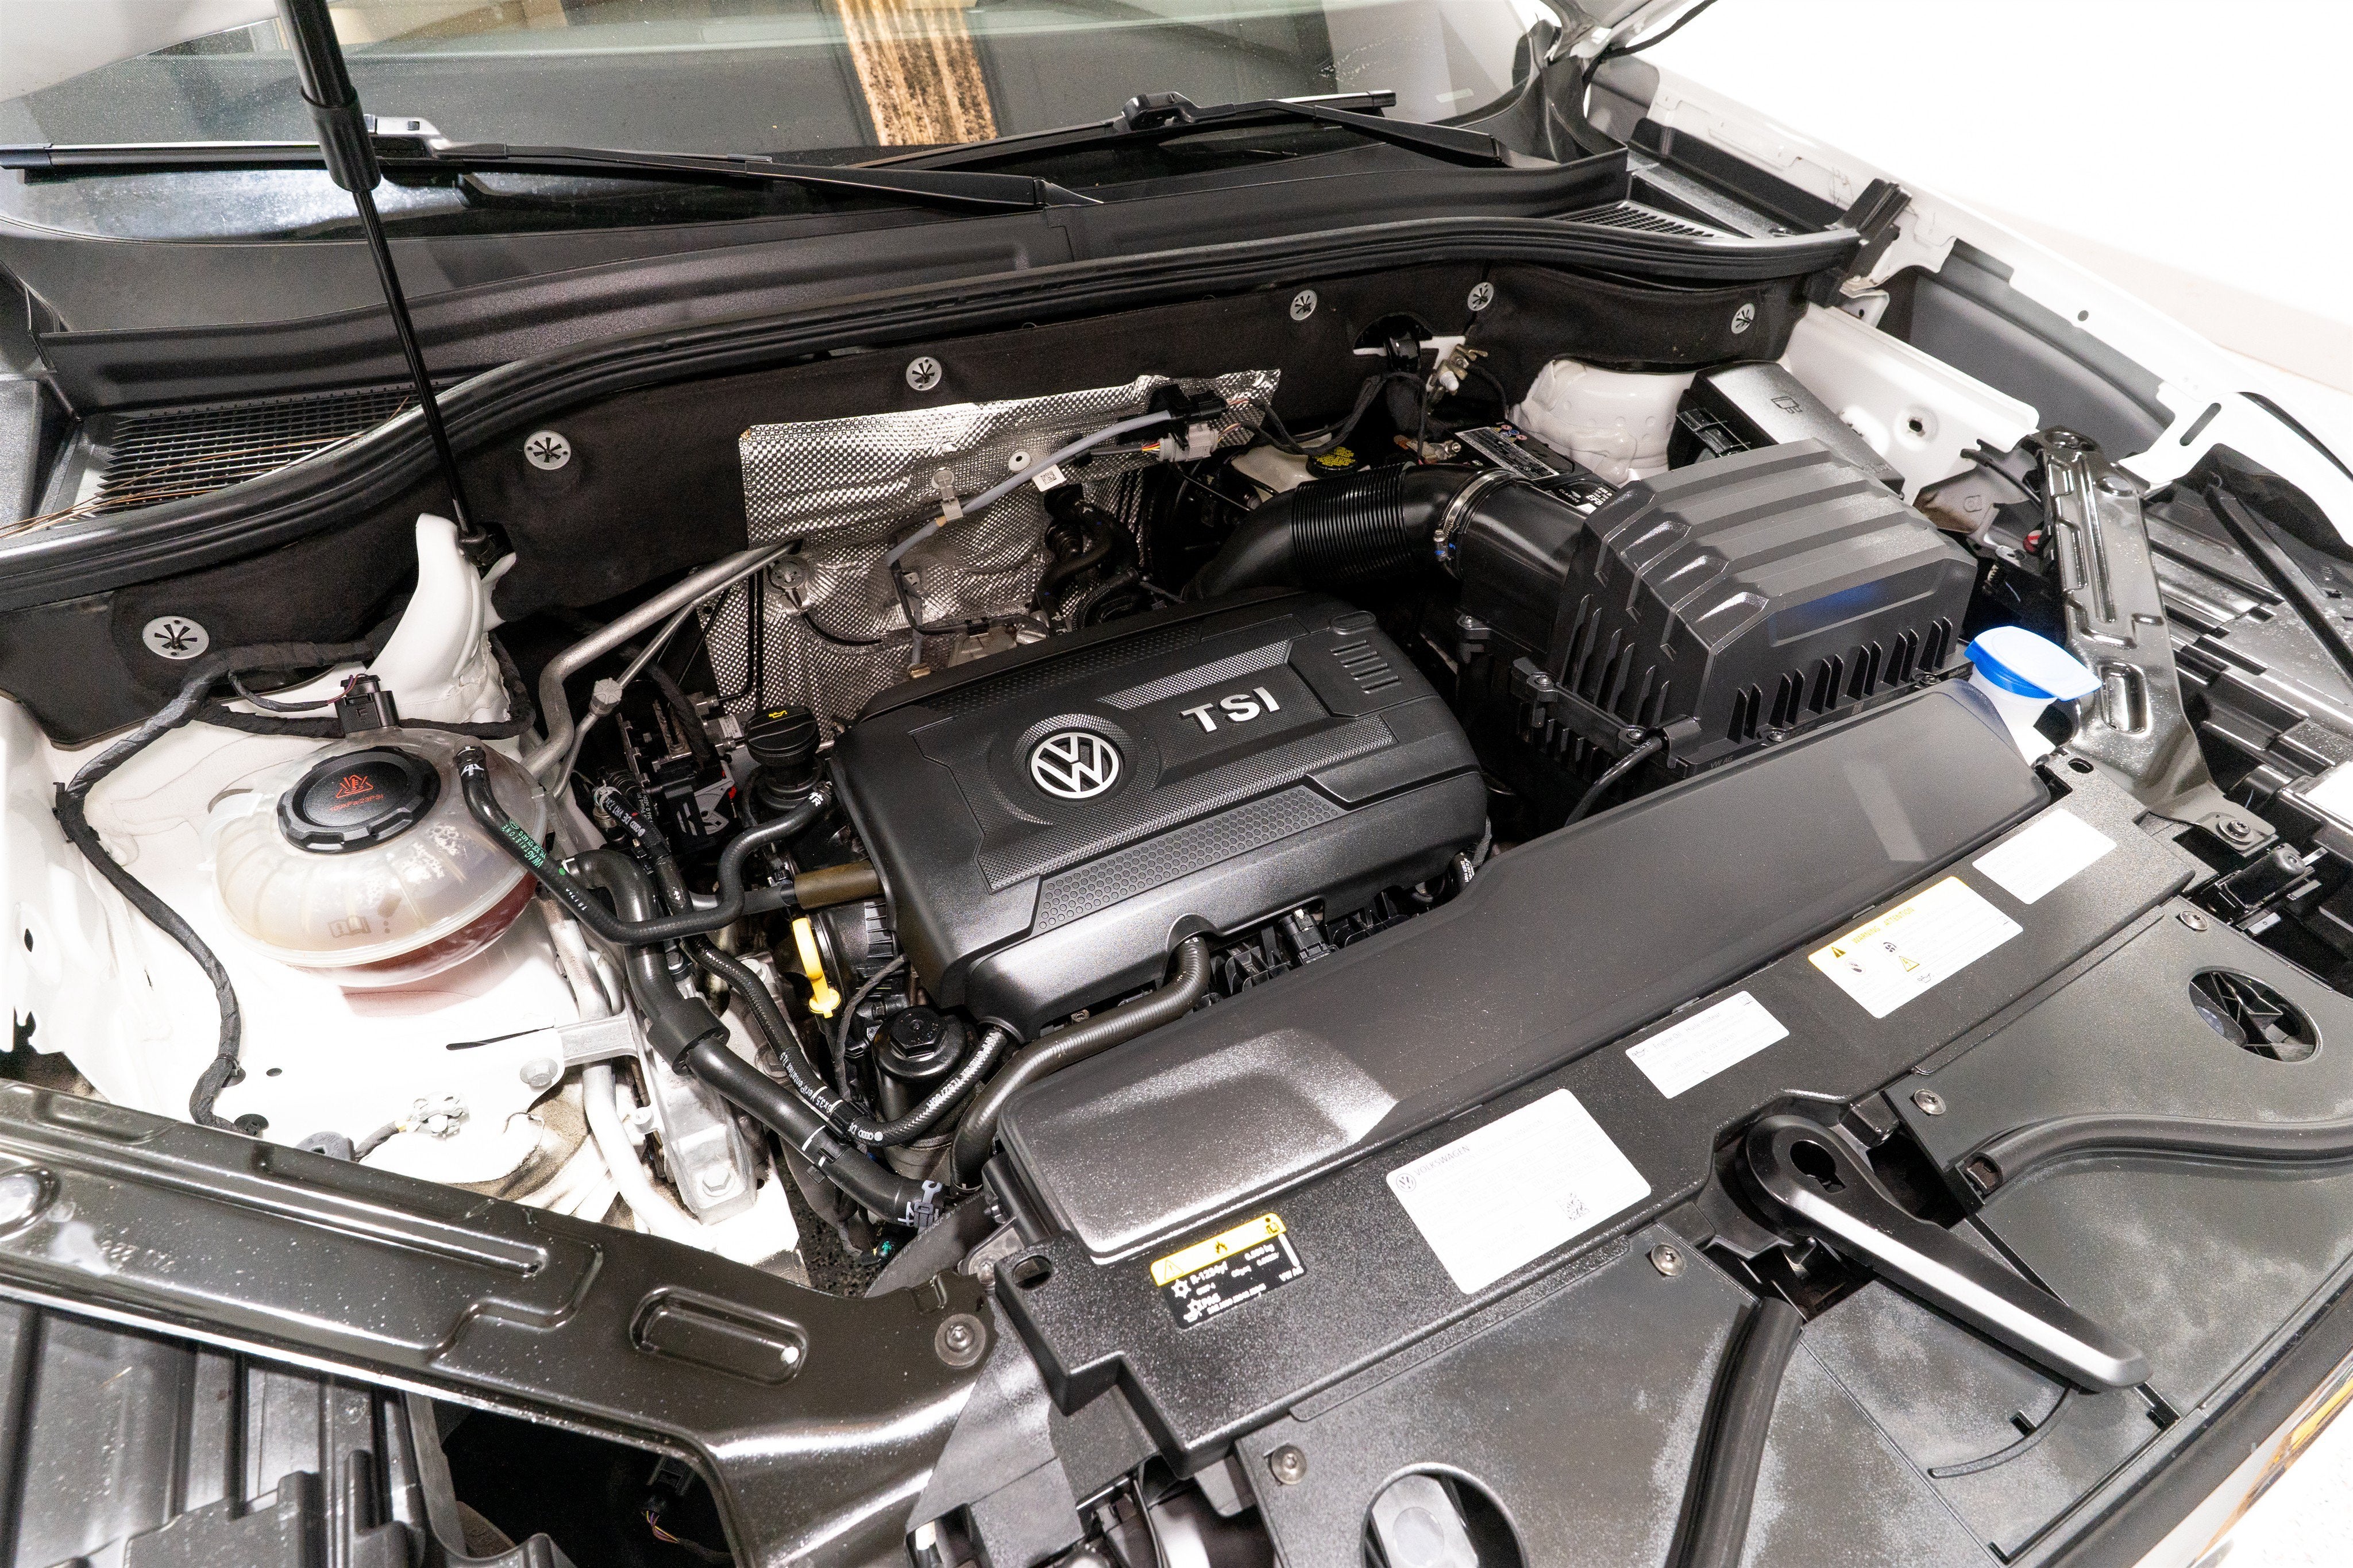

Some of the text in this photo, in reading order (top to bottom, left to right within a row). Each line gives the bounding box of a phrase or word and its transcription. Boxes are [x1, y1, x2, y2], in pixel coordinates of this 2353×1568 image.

[1559, 489, 1579, 503] CLARIOS
[1180, 686, 1280, 733] TSI
[1852, 907, 1914, 944] WARNING ATTENTION
[1652, 1036, 1673, 1049] Engine
[1413, 1144, 1471, 1177] VOLKSWAGEN
